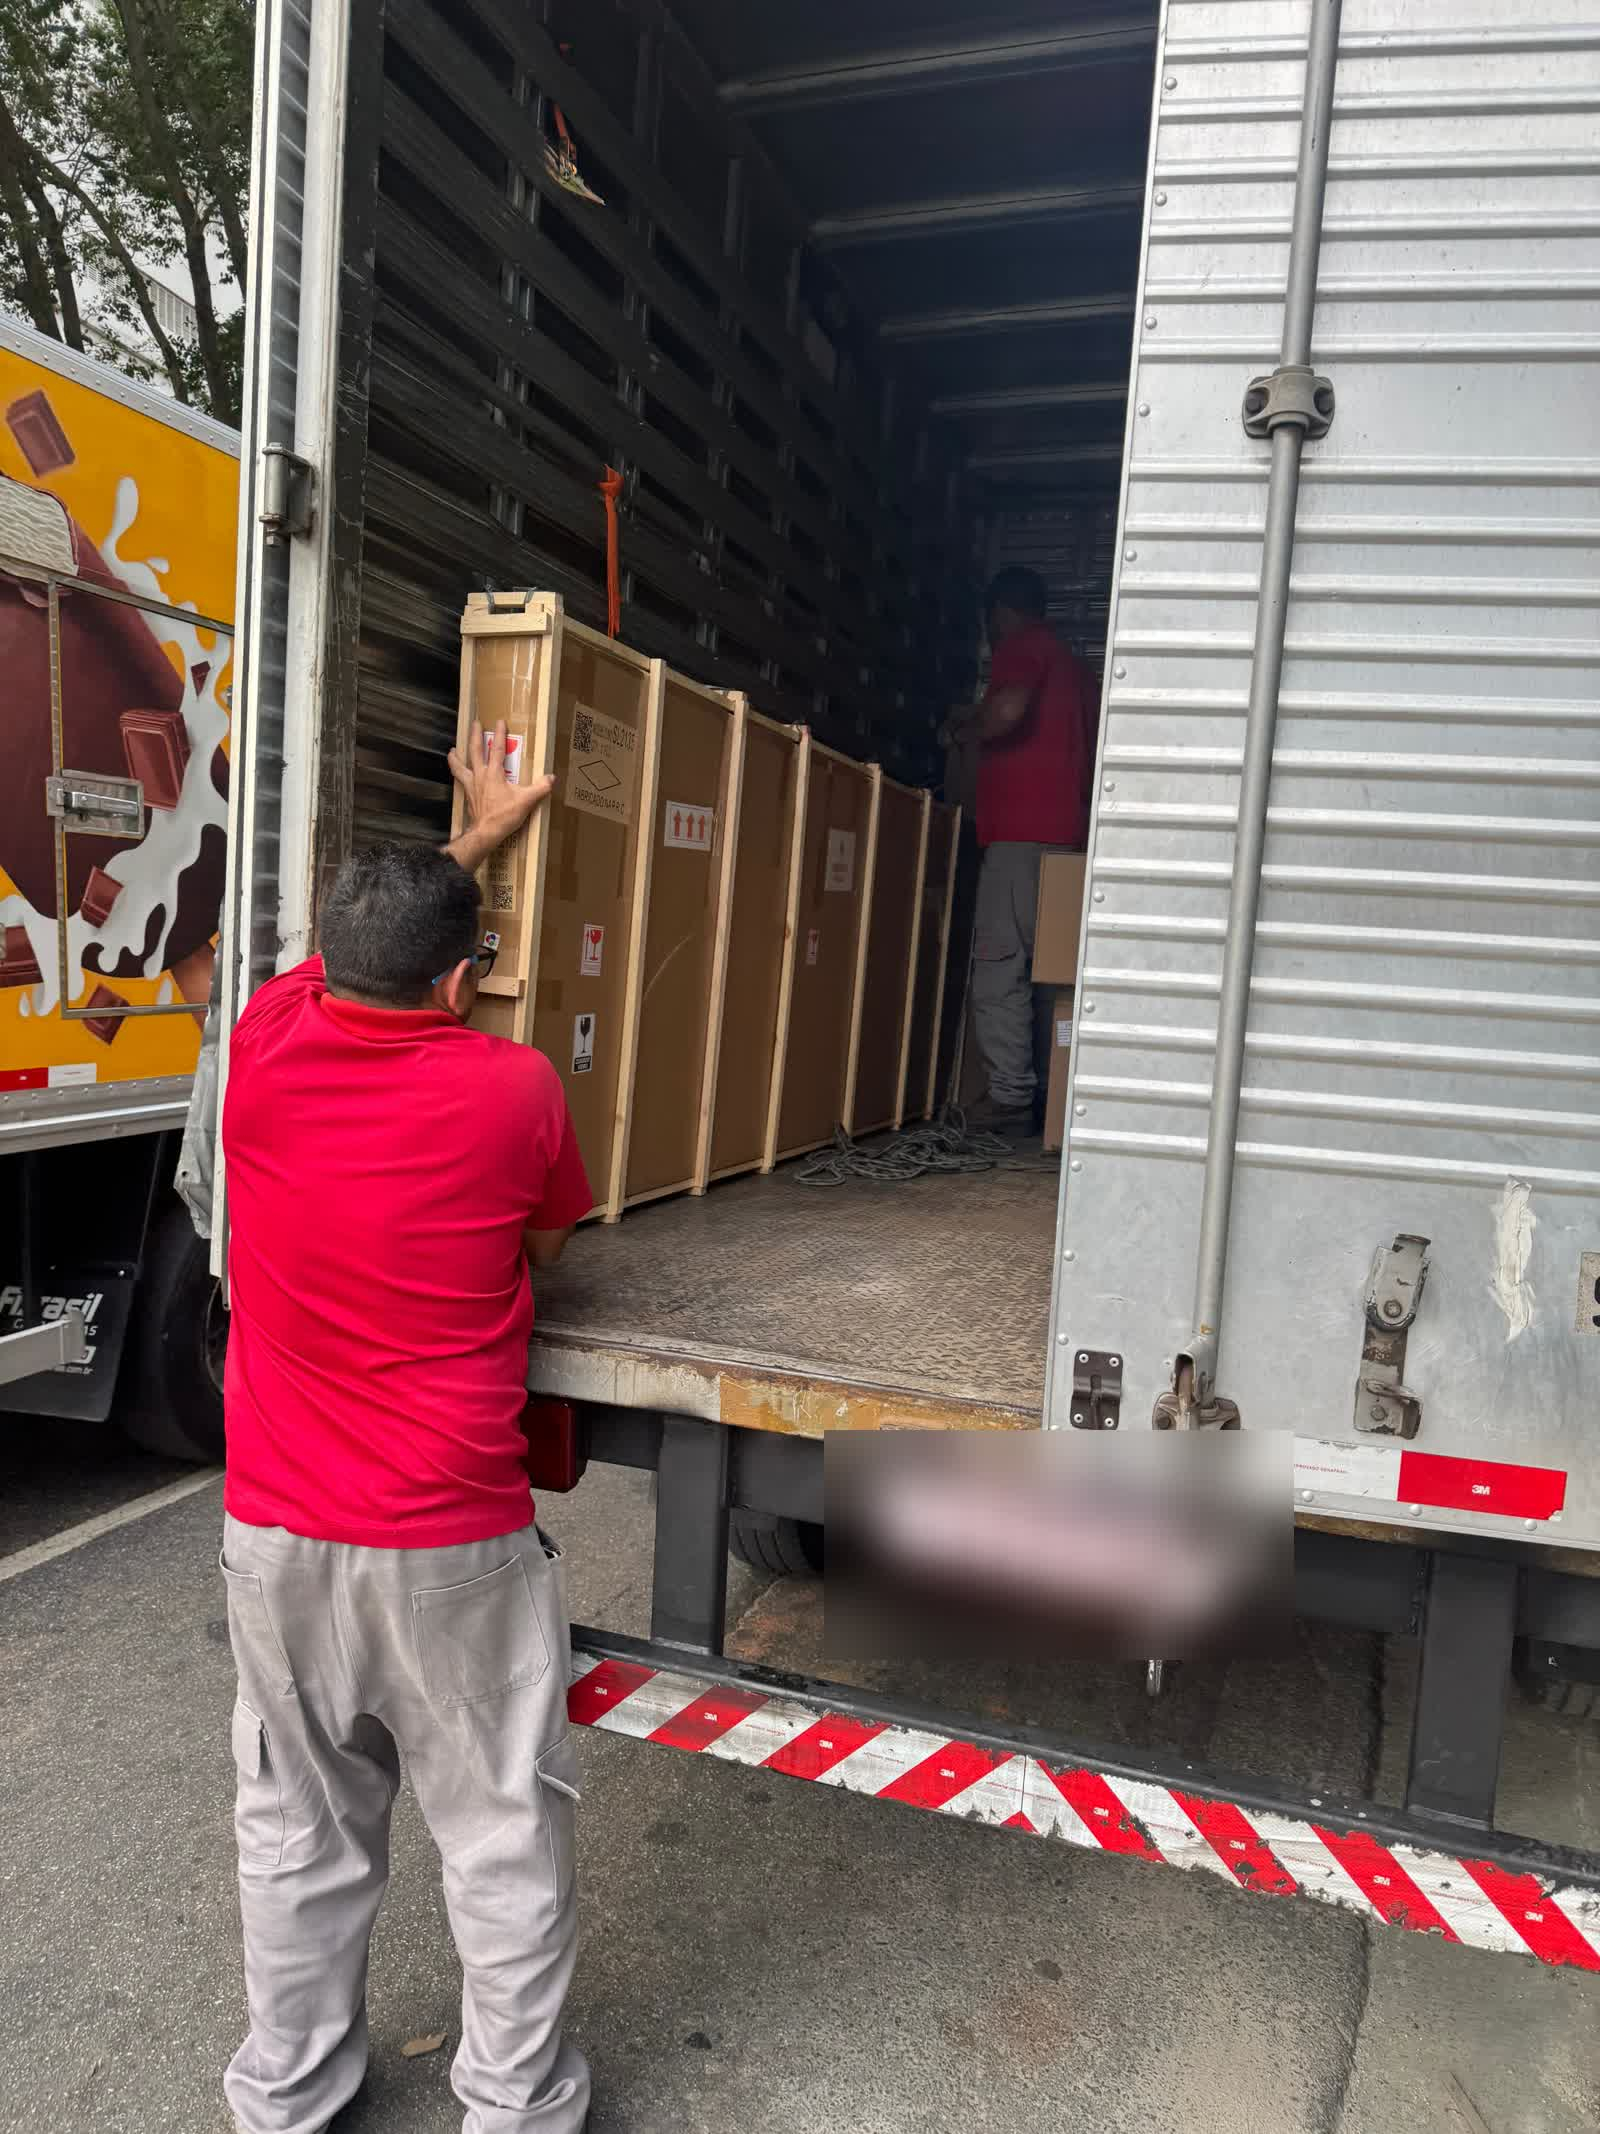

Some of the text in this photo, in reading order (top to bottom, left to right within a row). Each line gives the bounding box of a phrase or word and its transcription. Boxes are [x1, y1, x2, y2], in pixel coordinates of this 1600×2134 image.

[1471, 1484, 1491, 1495] 3M
[594, 1686, 608, 1696] 3M
[703, 1712, 718, 1722] 3M
[819, 1739, 833, 1750] 3M
[940, 1768, 955, 1779] 3M
[1093, 1806, 1109, 1817] 3M
[1229, 1839, 1246, 1851] 3M
[1373, 1875, 1391, 1886] 3M
[1525, 1911, 1544, 1923] 3M
